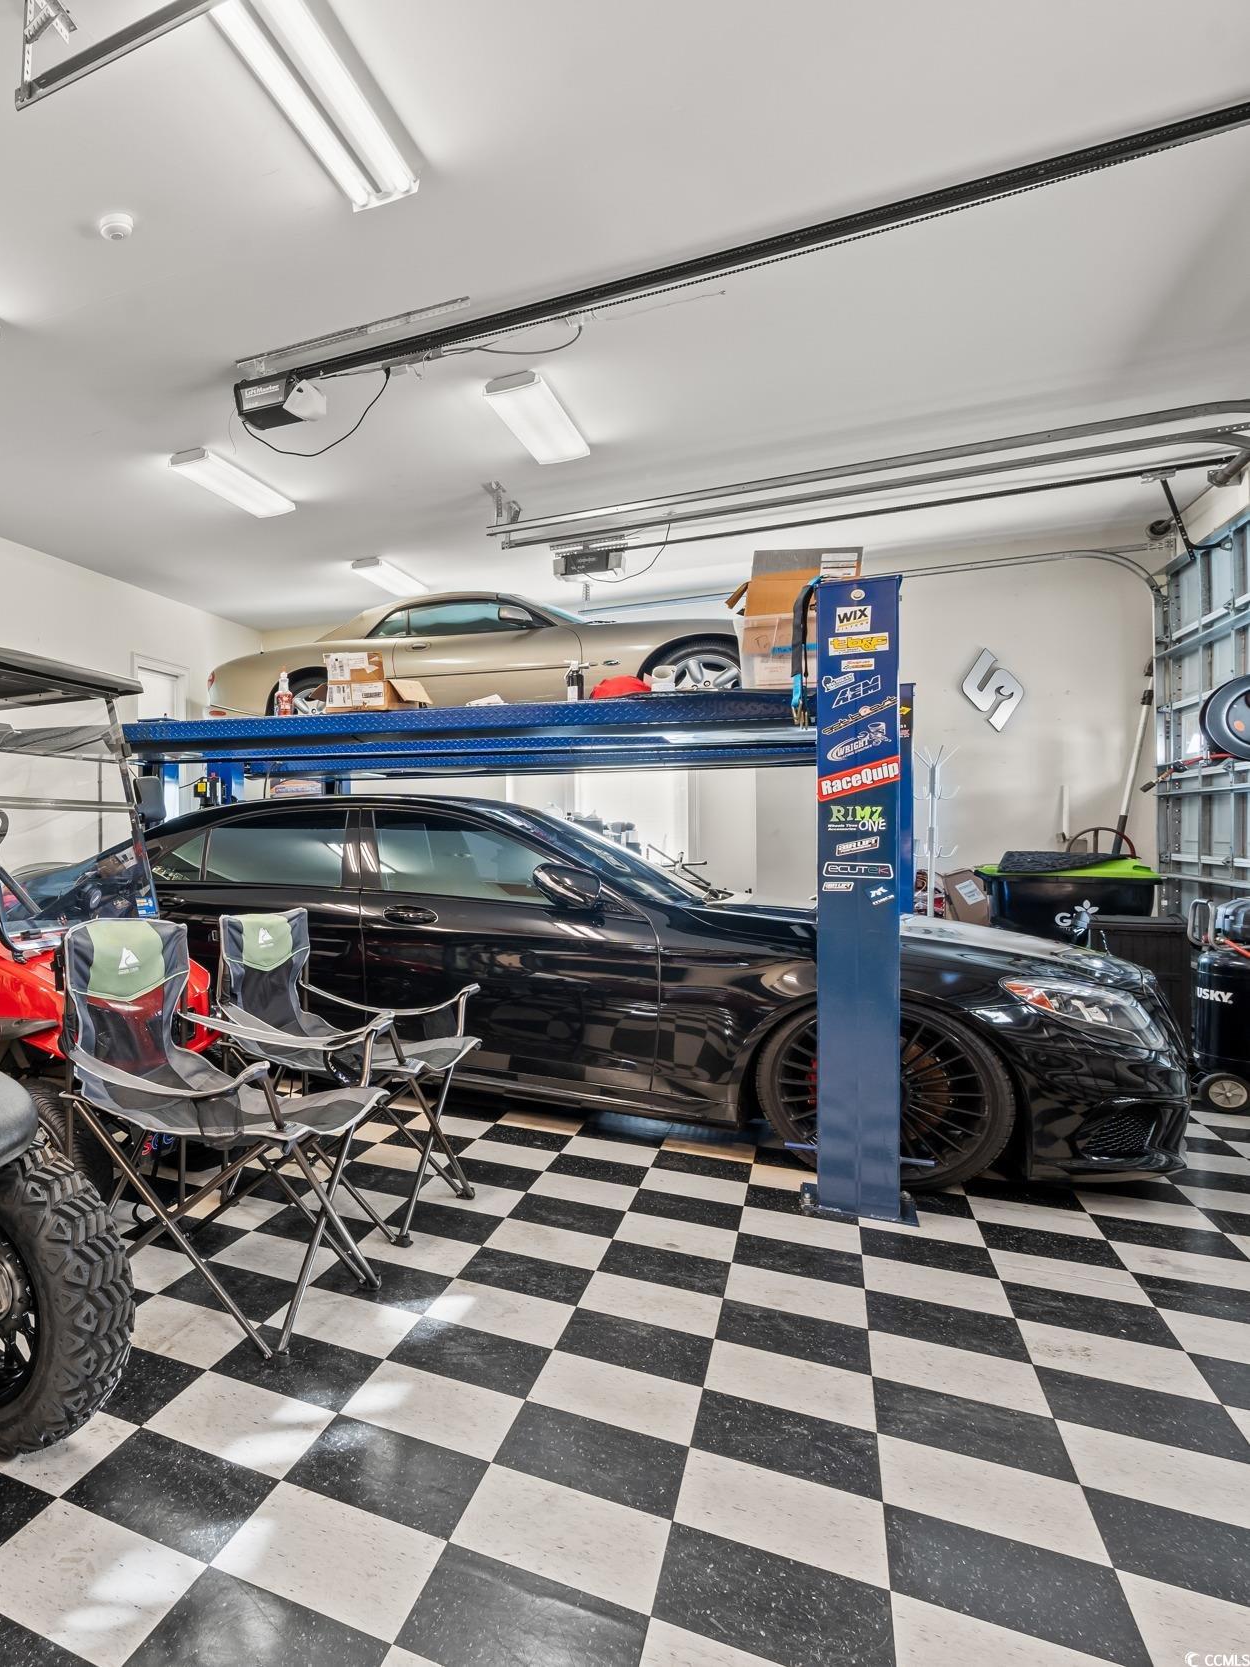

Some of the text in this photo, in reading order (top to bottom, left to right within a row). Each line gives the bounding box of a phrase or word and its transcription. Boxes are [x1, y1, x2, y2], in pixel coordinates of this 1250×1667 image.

[838, 607, 868, 623] WIX
[832, 674, 881, 709] AEM
[836, 738, 869, 757] WRIGHT
[821, 762, 899, 796] RaceQuip
[830, 805, 883, 822] RIMZ
[858, 819, 887, 832] ONE
[1196, 986, 1234, 1003] USKY
